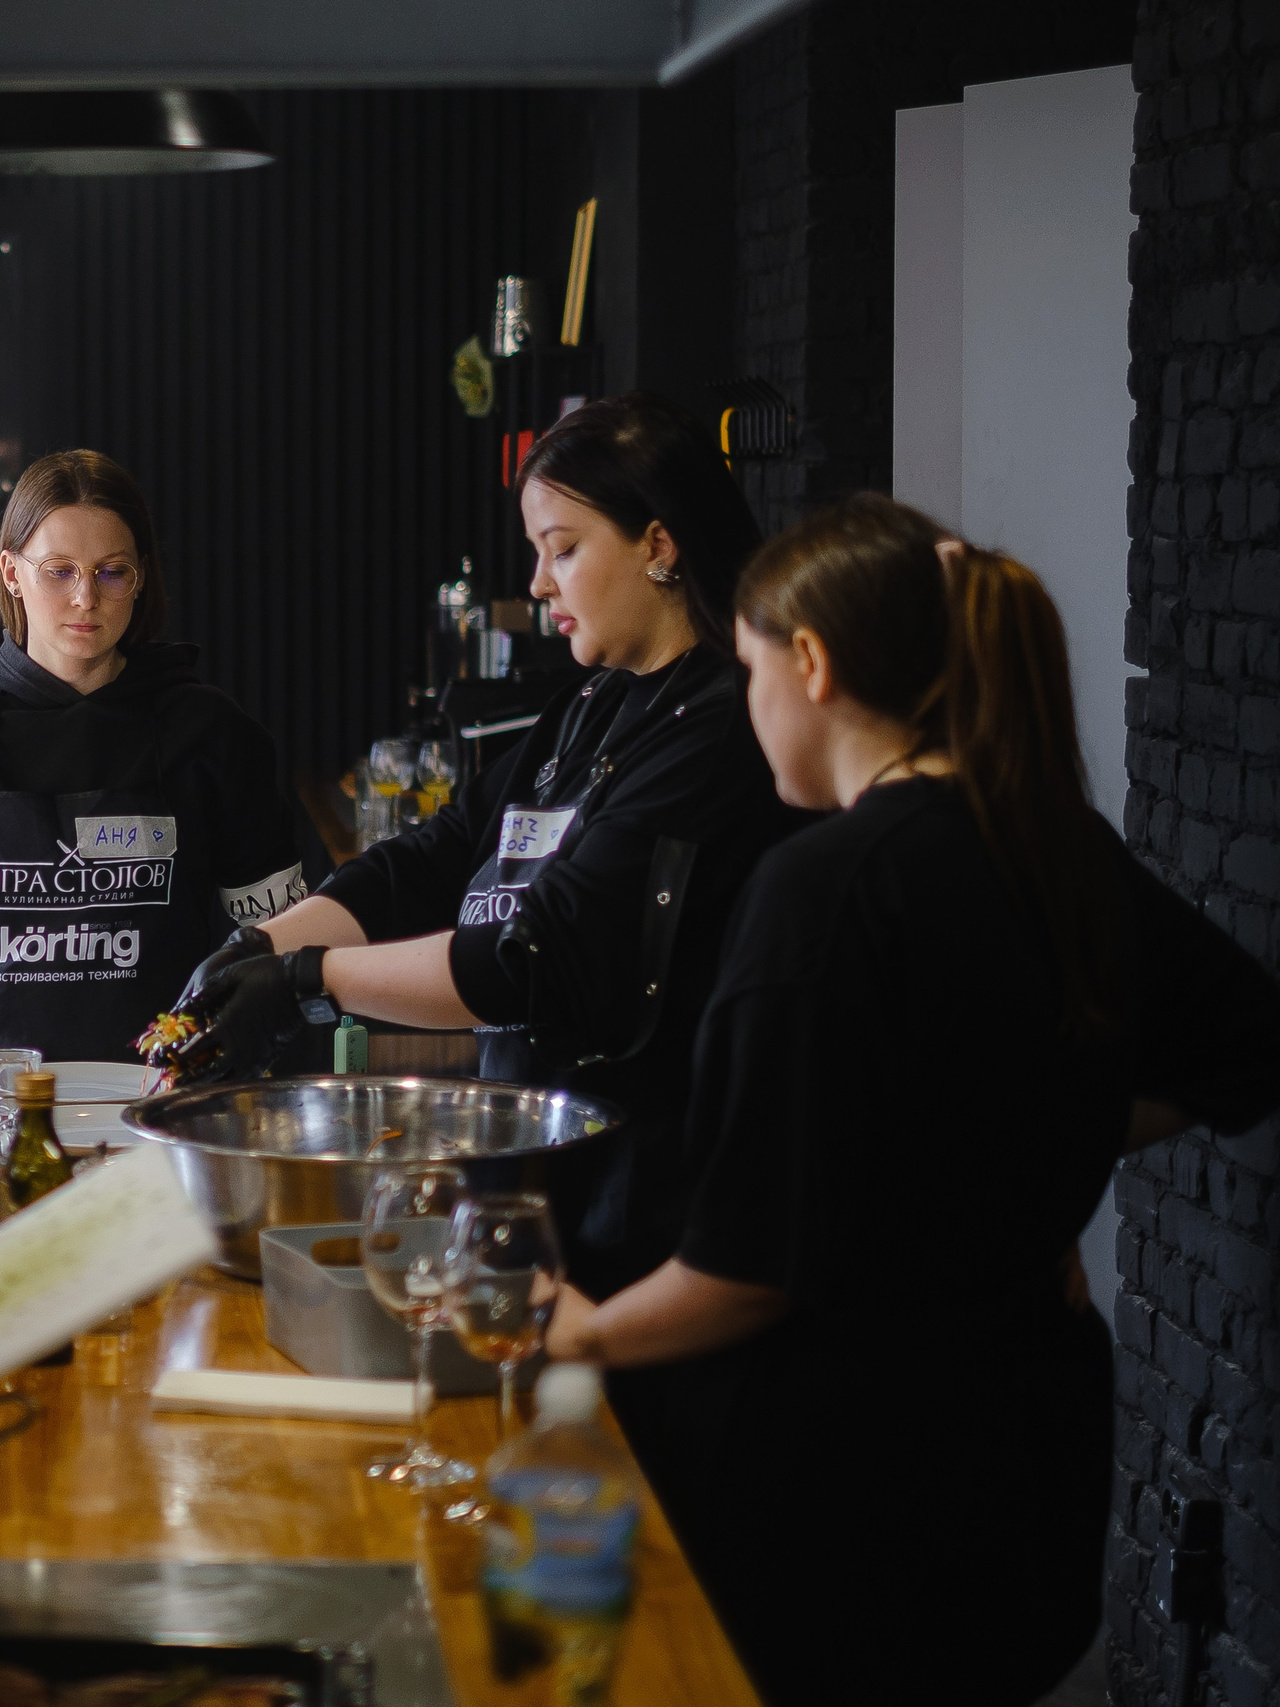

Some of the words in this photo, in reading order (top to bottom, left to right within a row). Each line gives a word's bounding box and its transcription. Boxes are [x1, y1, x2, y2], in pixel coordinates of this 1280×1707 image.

[95, 824, 138, 849] АНЯ
[54, 864, 166, 893] СТОЛОВ
[4, 896, 84, 904] КУЛИНАРНАЯ
[89, 892, 135, 903] СТУДИЯ
[0, 923, 140, 968] körting
[87, 968, 137, 981] техника
